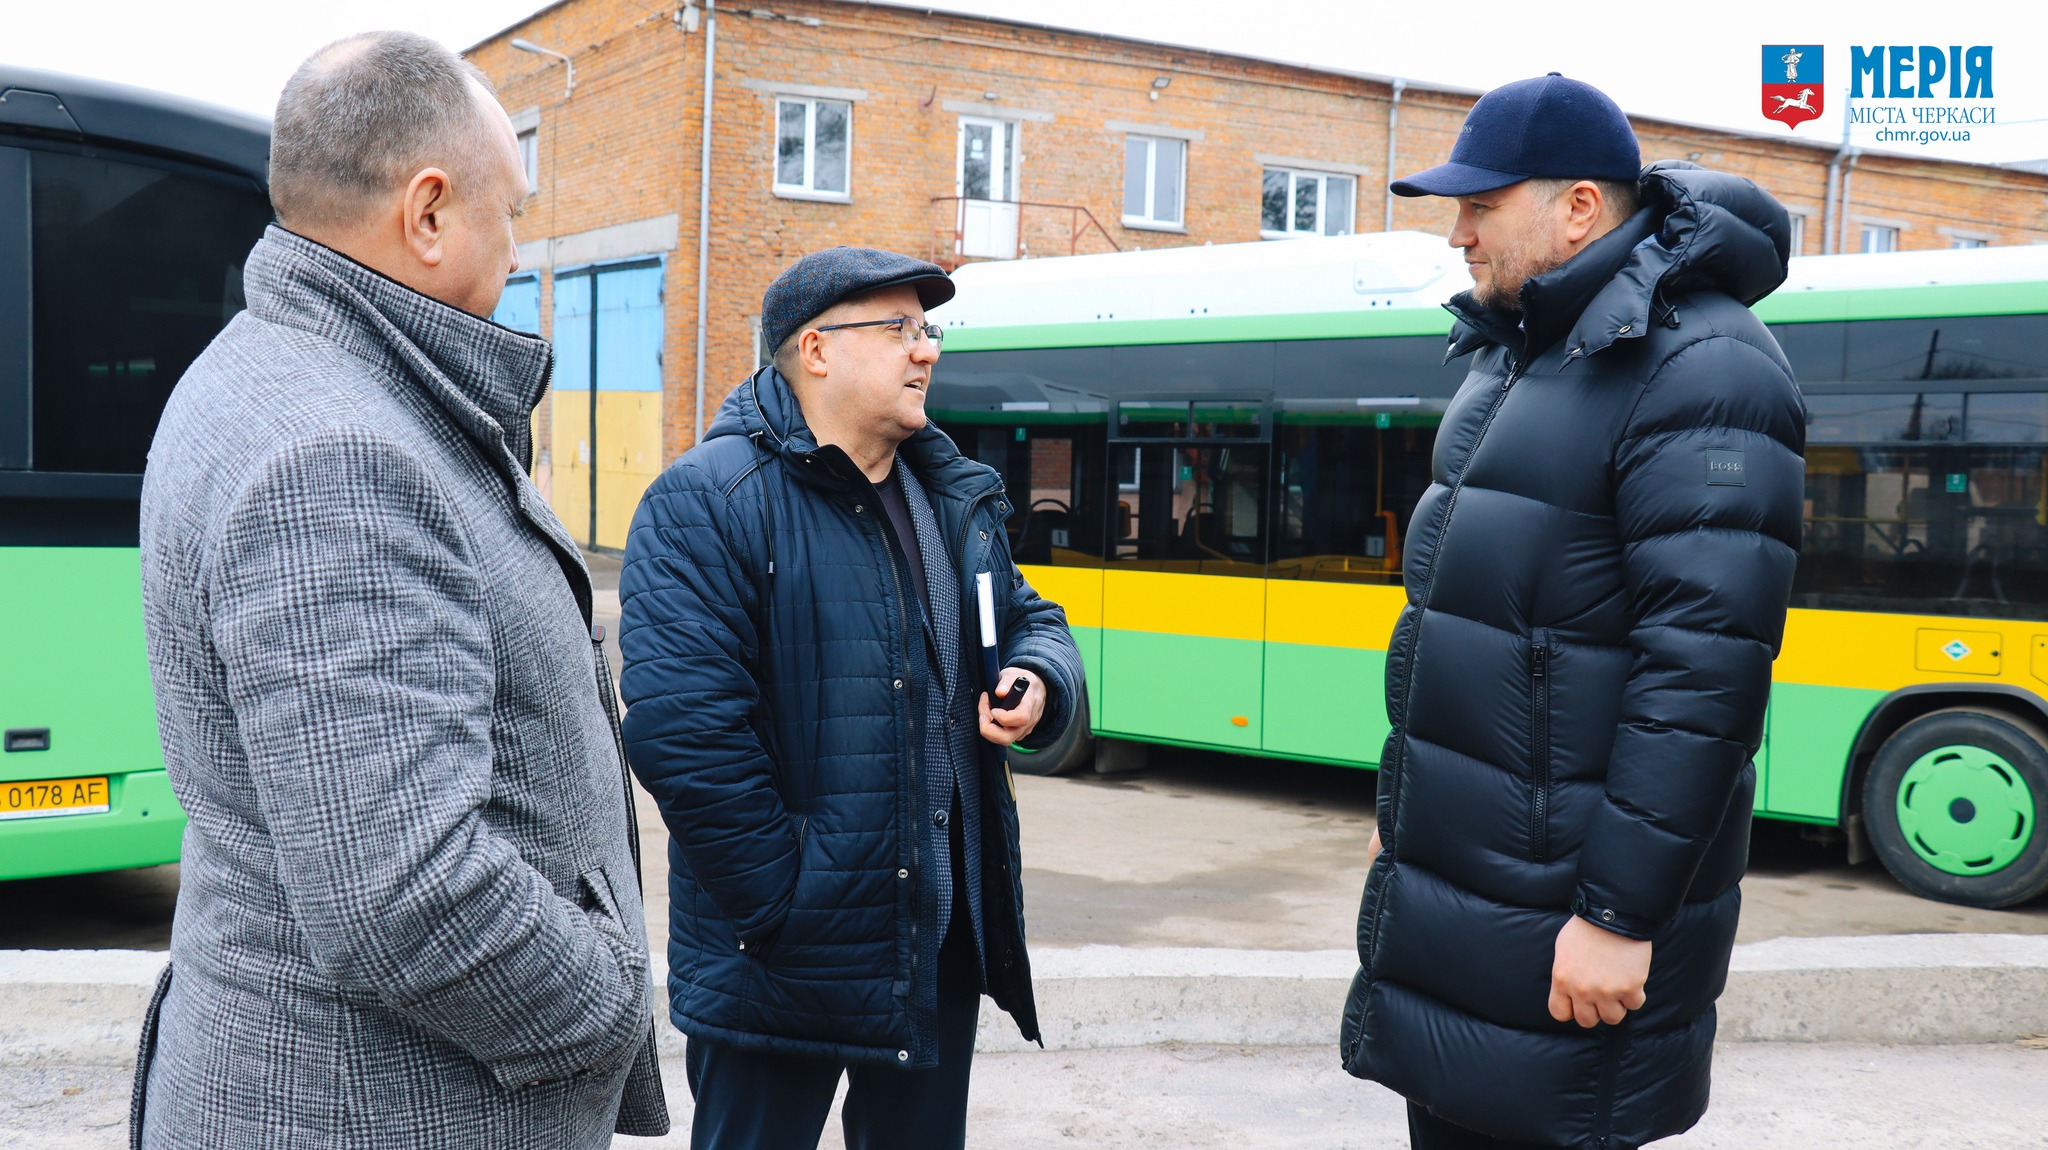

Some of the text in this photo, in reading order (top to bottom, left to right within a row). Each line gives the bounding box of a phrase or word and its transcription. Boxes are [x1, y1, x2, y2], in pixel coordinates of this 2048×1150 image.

[1710, 461, 1743, 471] BOSS
[9, 783, 103, 808] 0178 AF
